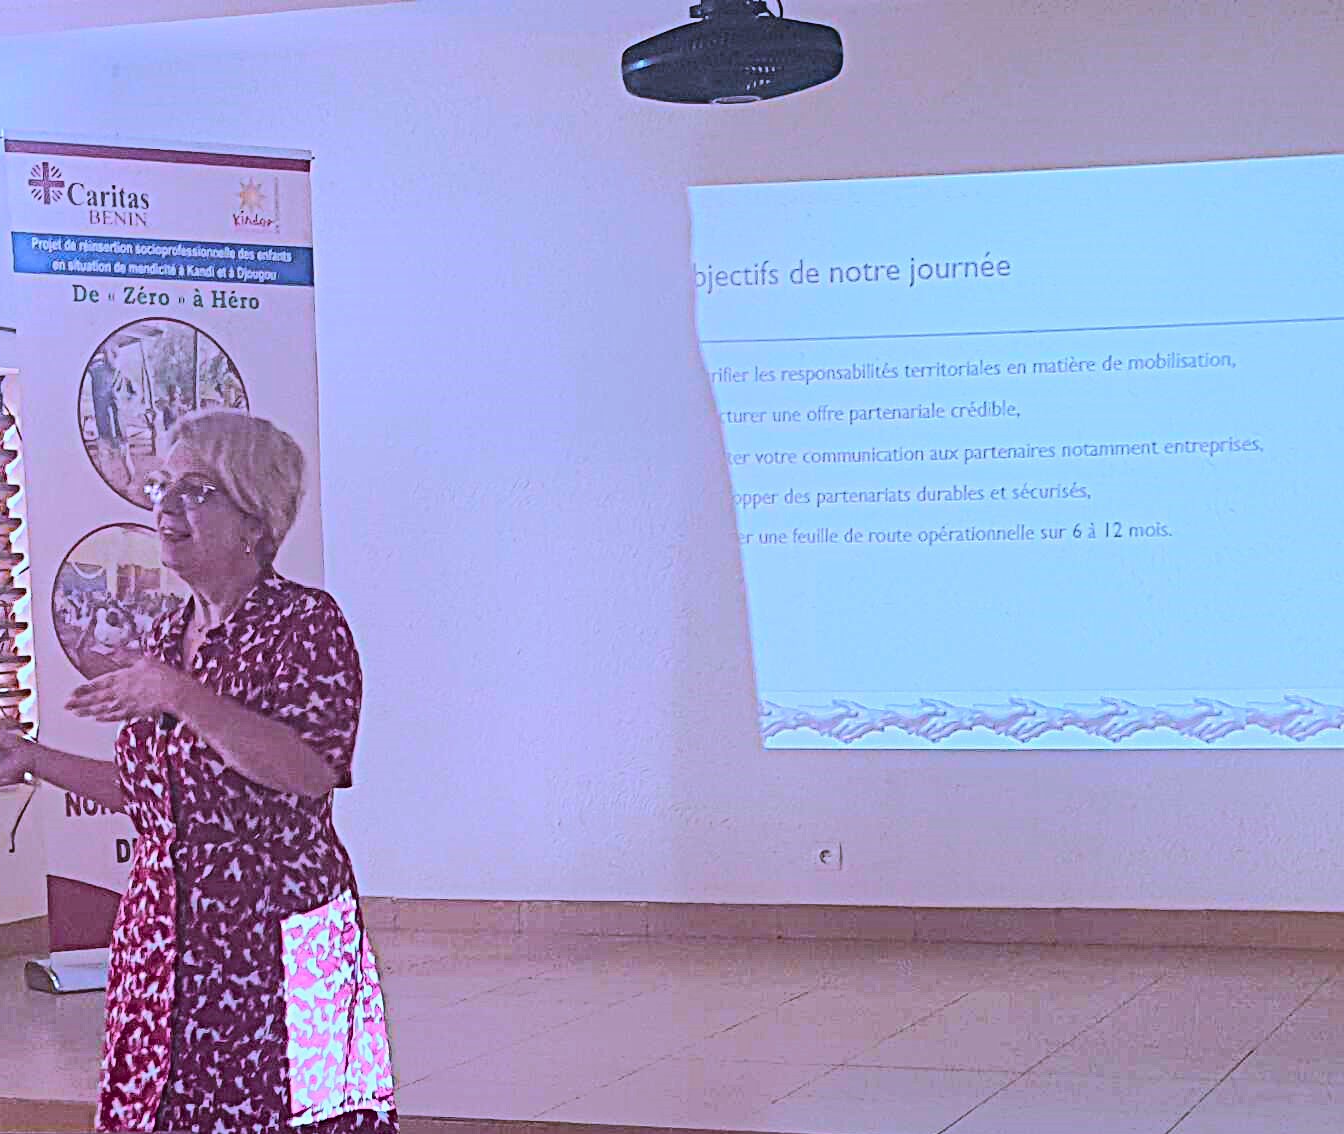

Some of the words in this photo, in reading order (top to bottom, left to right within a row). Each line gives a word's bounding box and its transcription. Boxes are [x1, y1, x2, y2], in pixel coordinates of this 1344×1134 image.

[67, 182, 150, 210] Caritas
[89, 209, 148, 227] BENIN
[31, 237, 63, 254] Projet
[64, 239, 78, 252] de
[78, 240, 134, 255] réinsertion
[135, 243, 236, 260] socioprofessionnelle
[237, 247, 256, 261] des
[256, 248, 293, 263] enfants
[52, 259, 66, 272] en
[67, 260, 112, 273] situation
[113, 262, 127, 275] de
[128, 262, 177, 277] mendicité
[178, 265, 185, 276] à
[186, 264, 215, 278] Kandi
[216, 266, 227, 279] et
[228, 266, 236, 279] à
[236, 266, 278, 282] Djougou
[789, 258, 820, 285] de
[829, 261, 901, 284] notre
[909, 250, 1012, 288] journée
[72, 284, 99, 303] De
[123, 286, 171, 306] Zéro
[193, 288, 204, 308] à
[211, 290, 260, 310] Héro
[754, 365, 776, 382] les
[781, 361, 898, 385] responsabilités
[904, 359, 1001, 379] territoriales
[1007, 361, 1027, 375] en
[1032, 355, 1096, 374] matière
[1101, 354, 1123, 372] de
[1127, 350, 1238, 371] mobilisation,
[772, 409, 801, 423] une
[806, 404, 845, 422] offre
[849, 401, 946, 425] partenariale
[950, 399, 1022, 420] crédible,
[755, 450, 799, 465] votre
[802, 445, 925, 465] communication
[929, 446, 960, 462] aux
[964, 442, 1056, 465] partenaires
[1061, 440, 1160, 458] notamment
[1164, 435, 1265, 457] entreprises,
[783, 487, 811, 505] des
[816, 485, 912, 508] partenariats
[917, 483, 986, 503] durables
[989, 486, 1007, 501] et
[1011, 482, 1092, 501] sécurisés,
[758, 530, 788, 545] une
[792, 525, 839, 545] feuille
[842, 525, 864, 544] de
[868, 527, 914, 544] route
[918, 522, 1035, 545] opérationnelle
[1040, 527, 1067, 541] sur
[1072, 522, 1083, 540] 6
[1087, 522, 1097, 540] à
[1104, 521, 1124, 539] 12
[1129, 520, 1174, 539] mois.
